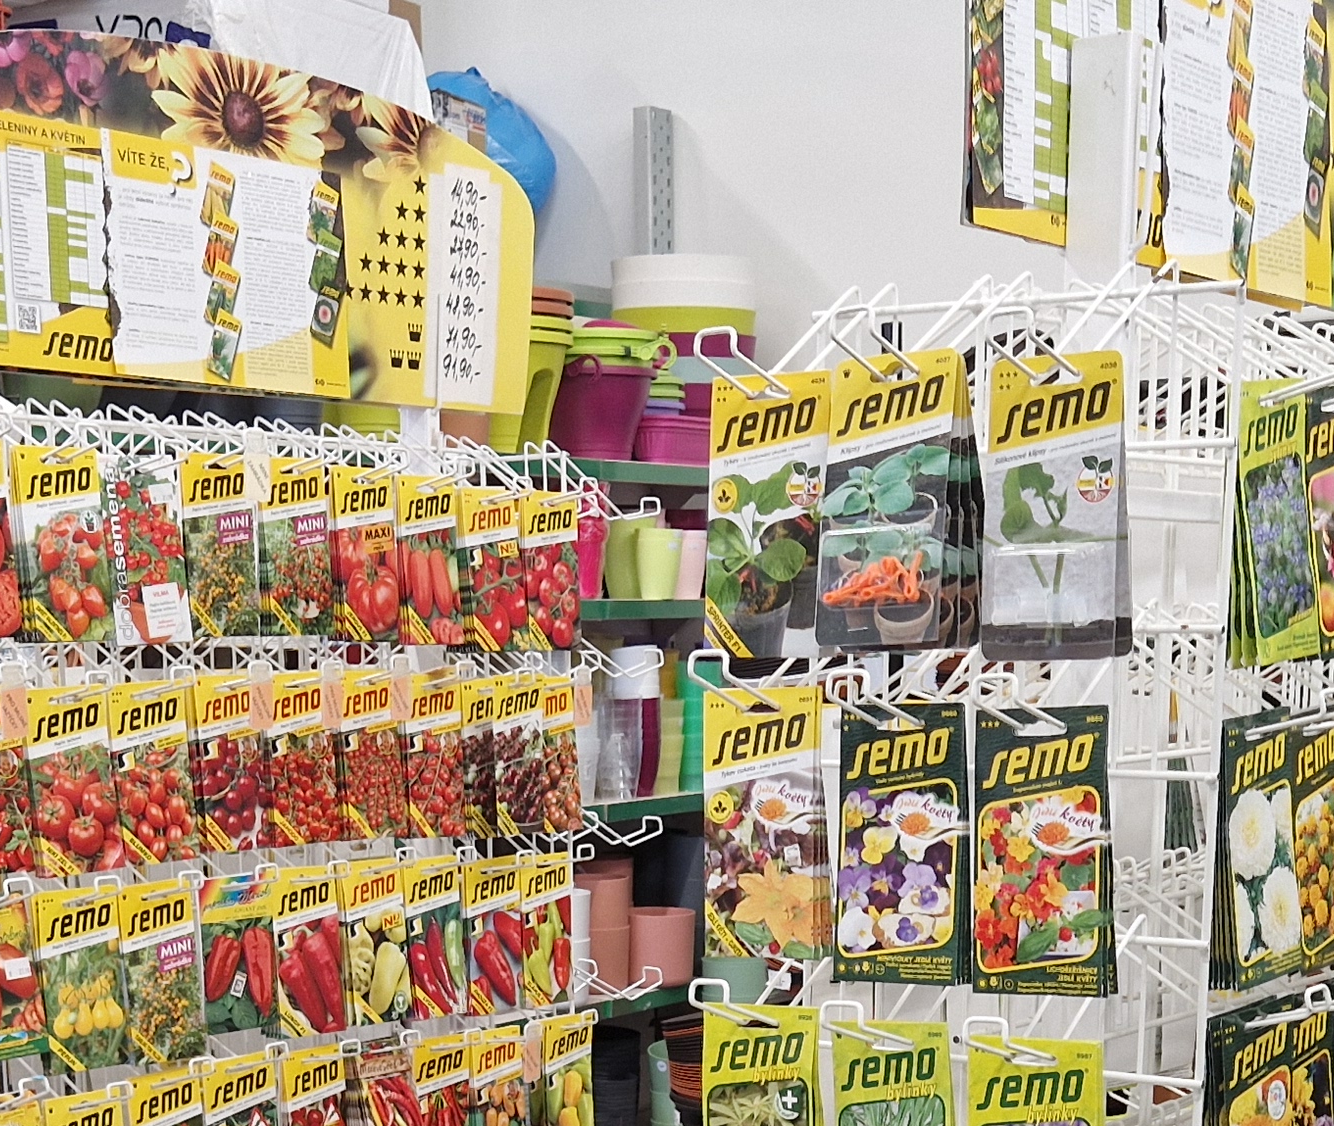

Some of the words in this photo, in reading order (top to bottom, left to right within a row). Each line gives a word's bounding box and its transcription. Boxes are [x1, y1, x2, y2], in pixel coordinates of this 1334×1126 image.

[41, 127, 49, 138] A
[50, 126, 86, 145] KVĚTIN
[117, 147, 146, 166] VÍTE
[43, 331, 113, 362] semo
[836, 374, 945, 437] semo
[996, 381, 1111, 445] semo
[717, 396, 817, 453] semo
[1245, 405, 1298, 458] semo
[27, 468, 91, 499] semo
[189, 473, 244, 502] semo
[341, 486, 388, 514] semo
[220, 513, 250, 530] MINI
[365, 526, 391, 541] MAXI
[528, 509, 572, 534] semo
[707, 606, 734, 643] SPRINTER
[411, 688, 455, 718] semo
[33, 702, 99, 742] semo
[712, 713, 806, 766] semo
[846, 728, 949, 780] semo
[982, 733, 1094, 790] semo
[1232, 732, 1286, 794] semo
[278, 880, 330, 917] semo
[48, 903, 111, 942] semo
[159, 940, 194, 960] MINI
[710, 1031, 805, 1073] semo
[841, 1046, 937, 1092] semo
[1231, 1023, 1287, 1087] semo
[211, 1070, 268, 1109] semo
[752, 1064, 801, 1083] bylinky
[886, 1081, 937, 1099] bylinky
[976, 1068, 1084, 1111] semo
[1026, 1105, 1079, 1124] bylinky
